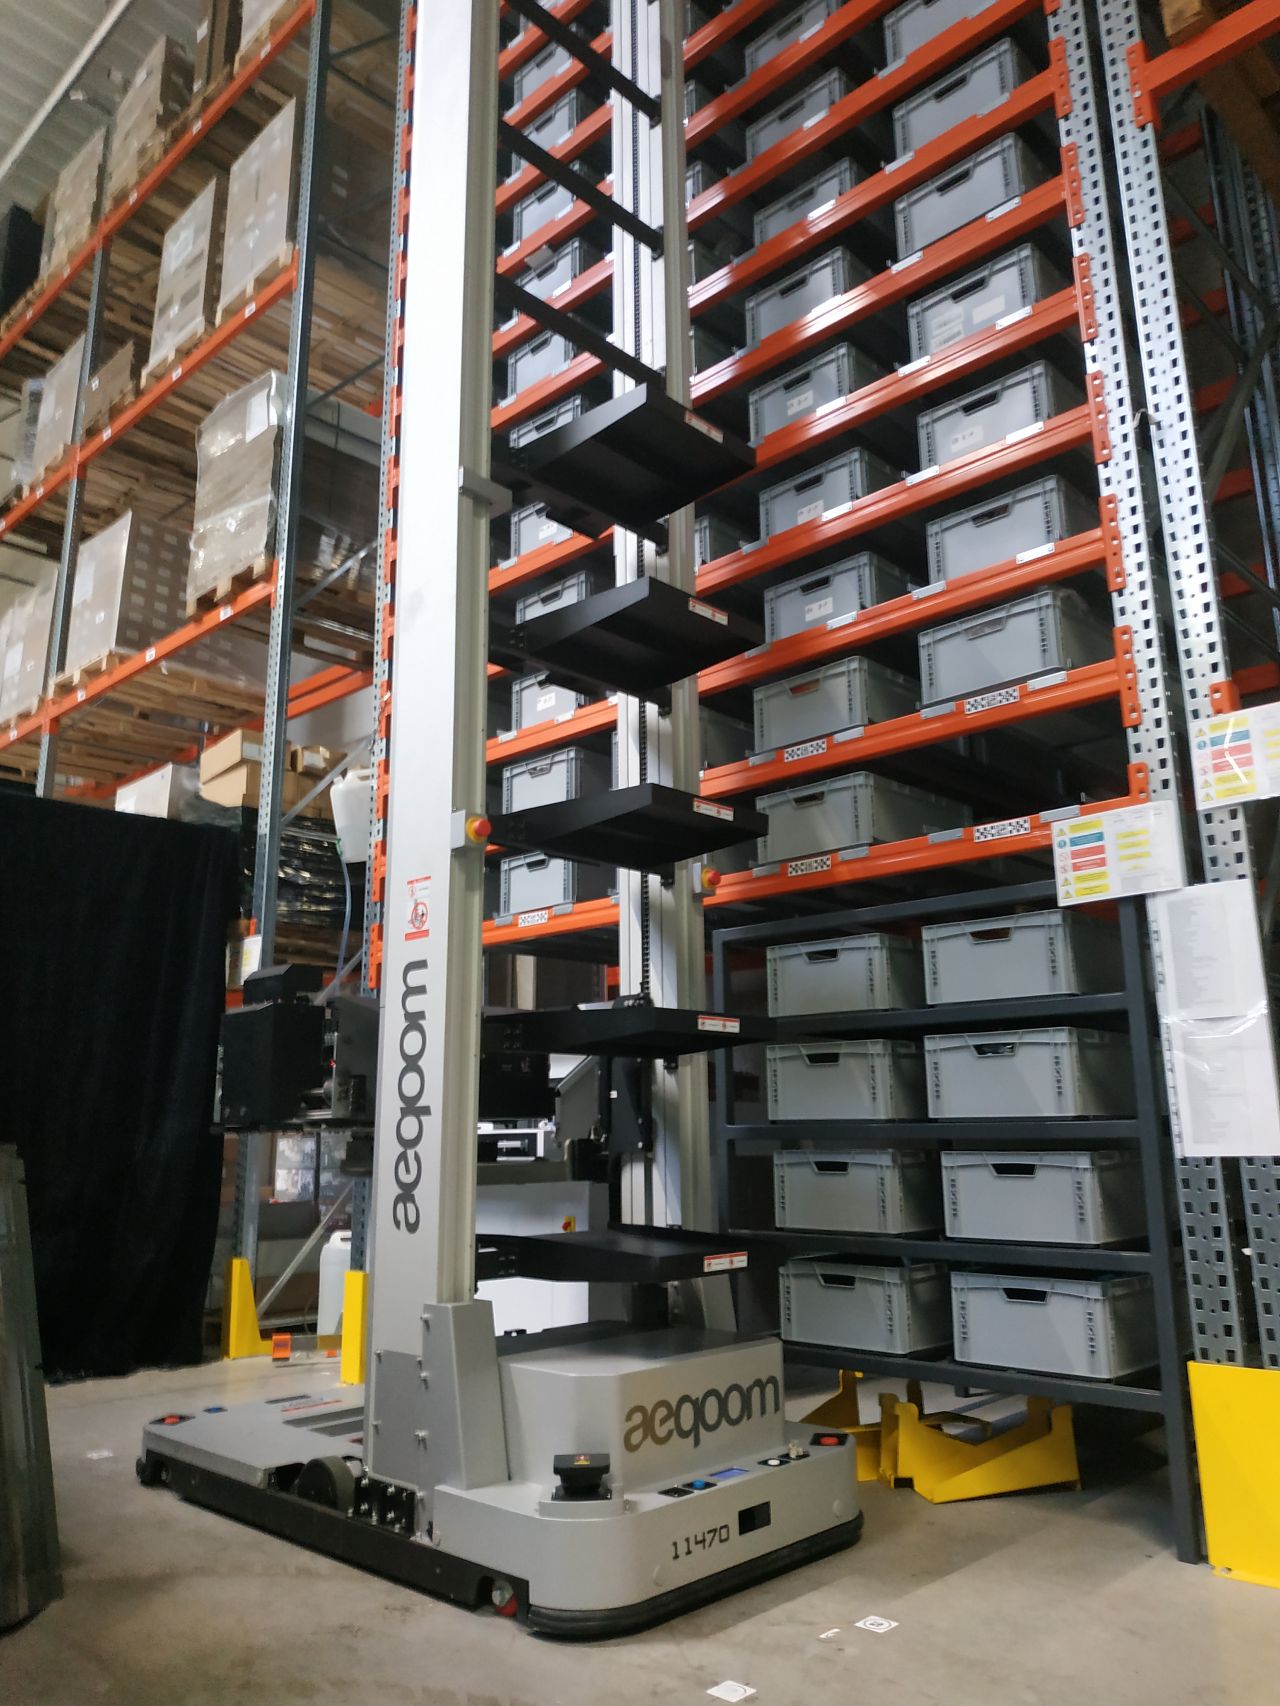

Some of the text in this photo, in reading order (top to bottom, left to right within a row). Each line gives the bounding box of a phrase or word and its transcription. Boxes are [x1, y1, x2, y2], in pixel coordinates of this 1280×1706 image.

[393, 960, 431, 1233] aeqoom
[624, 1376, 779, 1452] aeqoom
[672, 1525, 730, 1560] 11470
